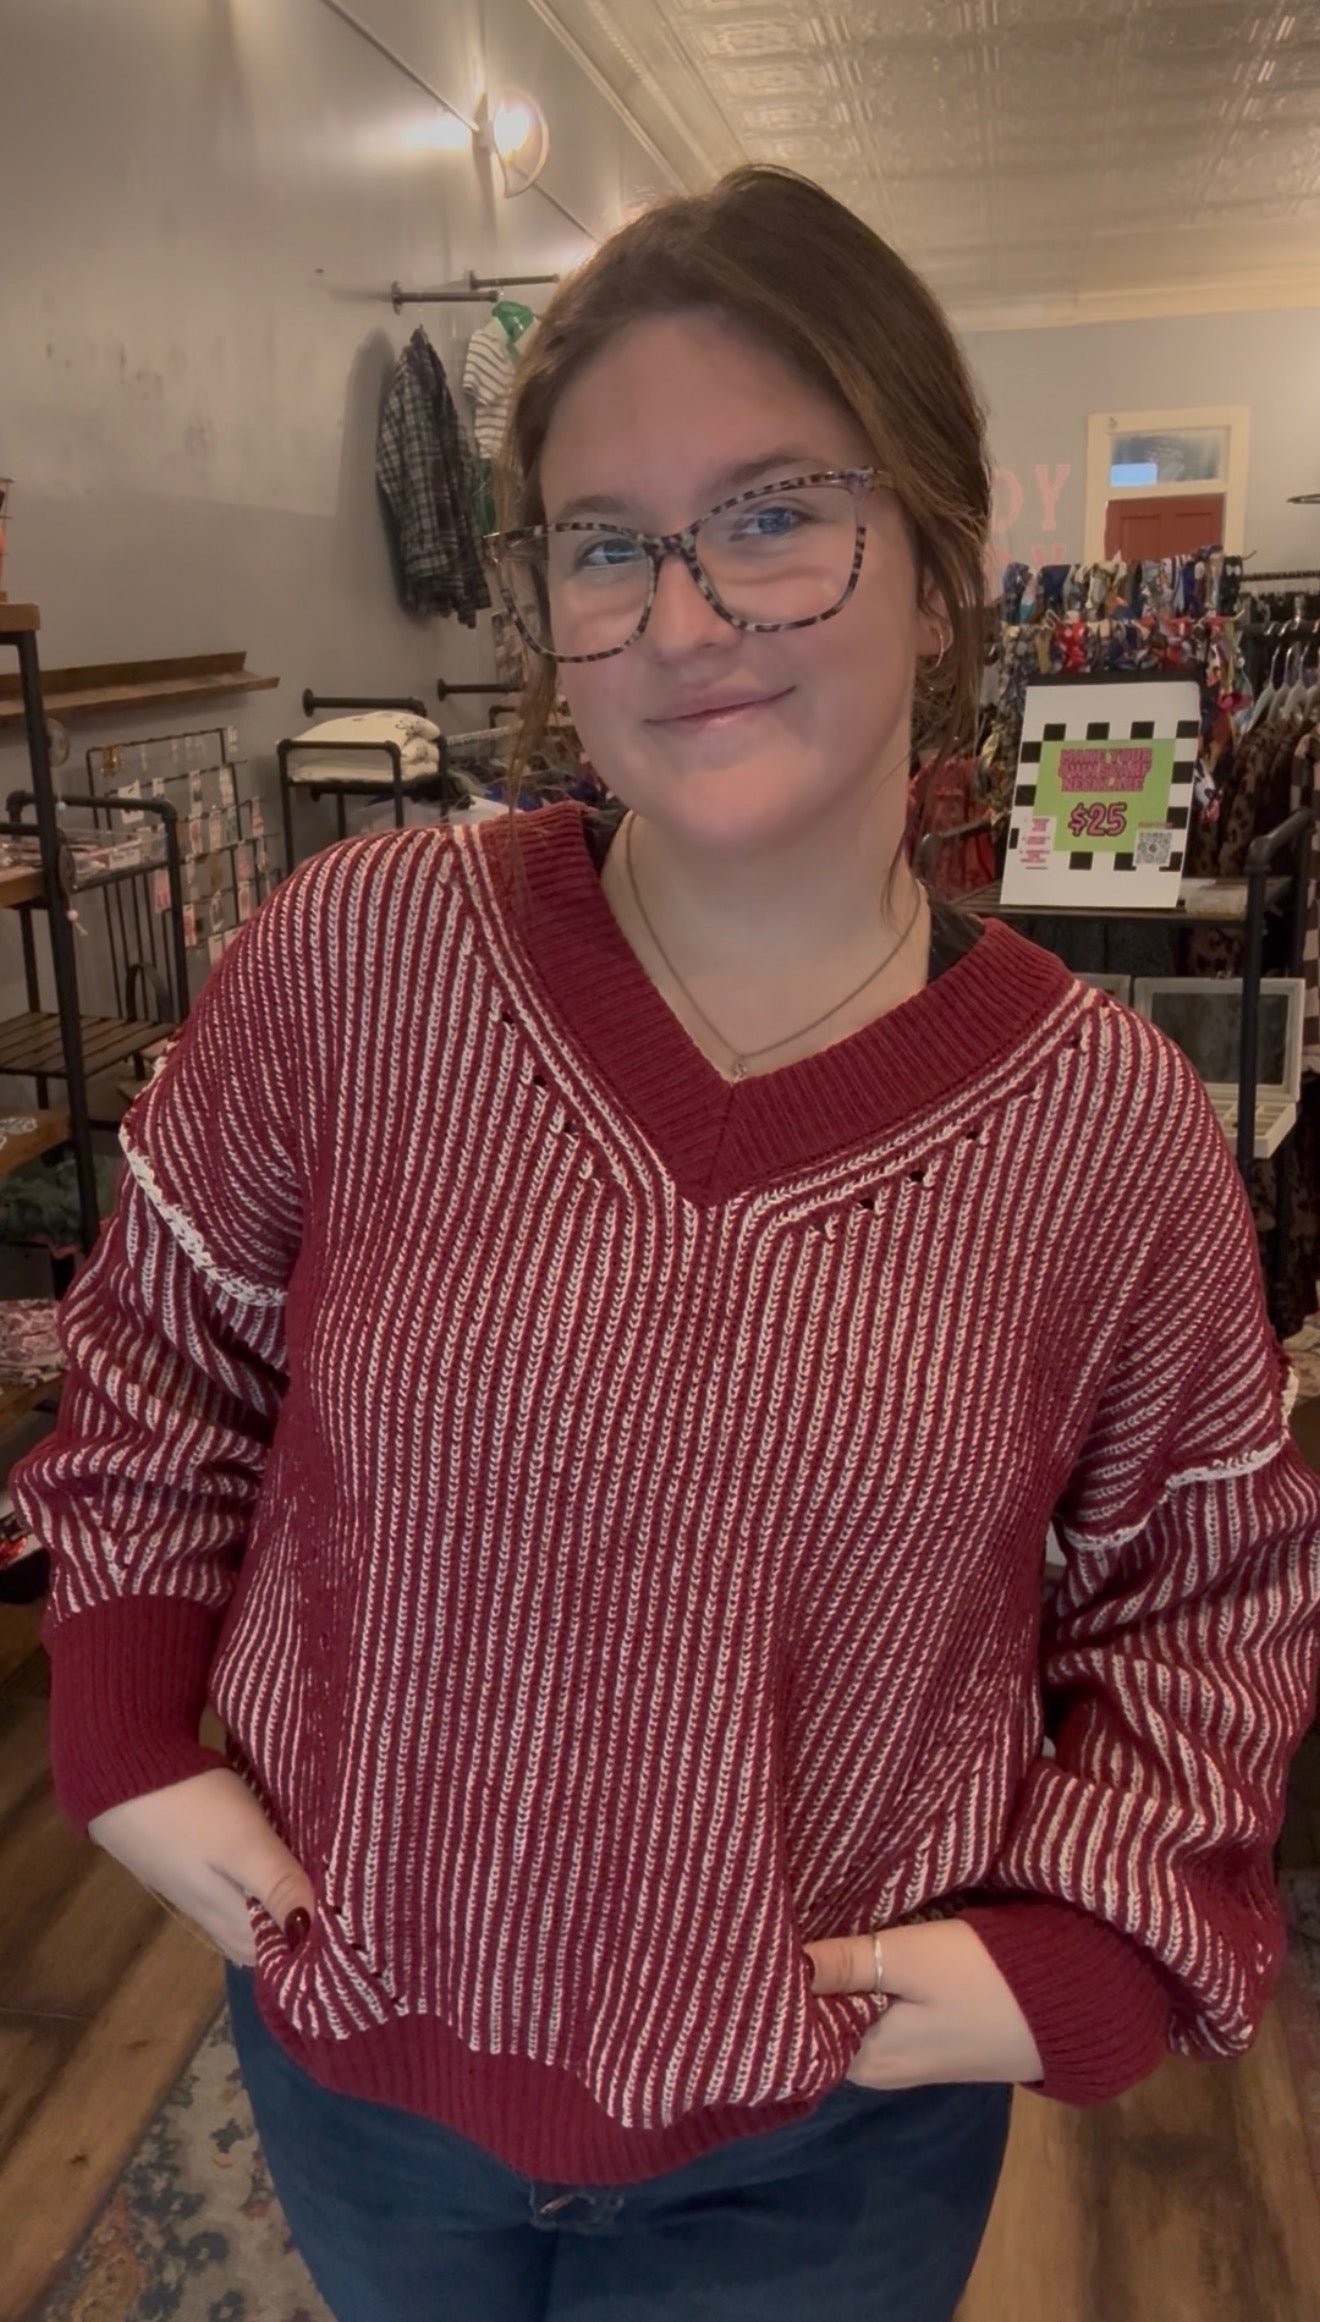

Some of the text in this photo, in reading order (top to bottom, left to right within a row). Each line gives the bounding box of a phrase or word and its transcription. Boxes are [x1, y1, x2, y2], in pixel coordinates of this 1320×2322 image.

[1108, 747, 1152, 763] YOUR
[1061, 776, 1143, 792] NECKLACE
[1068, 802, 1127, 837] $25
